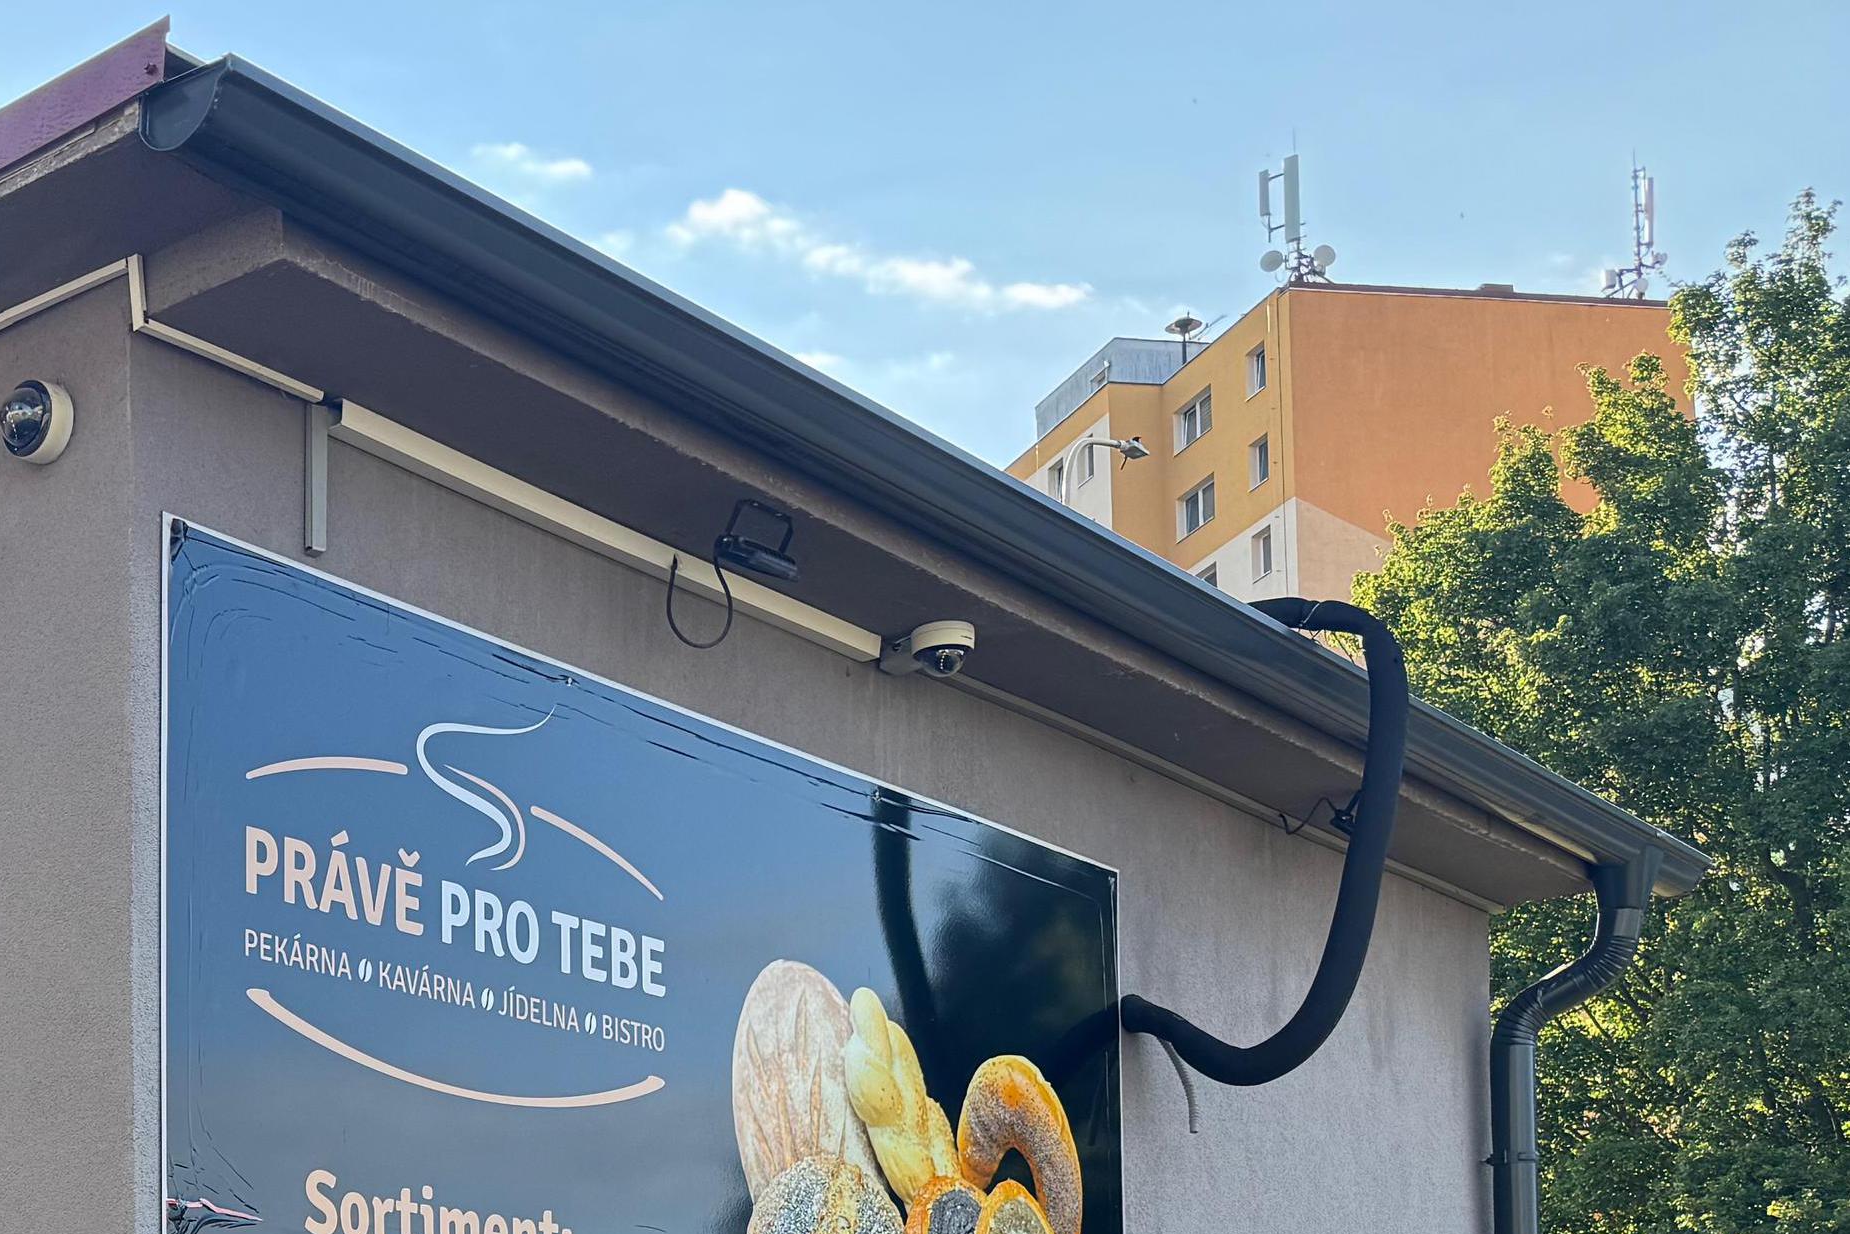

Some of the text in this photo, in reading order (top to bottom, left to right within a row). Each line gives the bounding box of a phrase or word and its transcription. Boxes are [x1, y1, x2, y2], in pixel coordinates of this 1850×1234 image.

[246, 825, 666, 997] PRÁVĚ PRO TEBE
[245, 929, 665, 1052] PEKÁRNA KAVÁRNA JÍDELNA BISTRO
